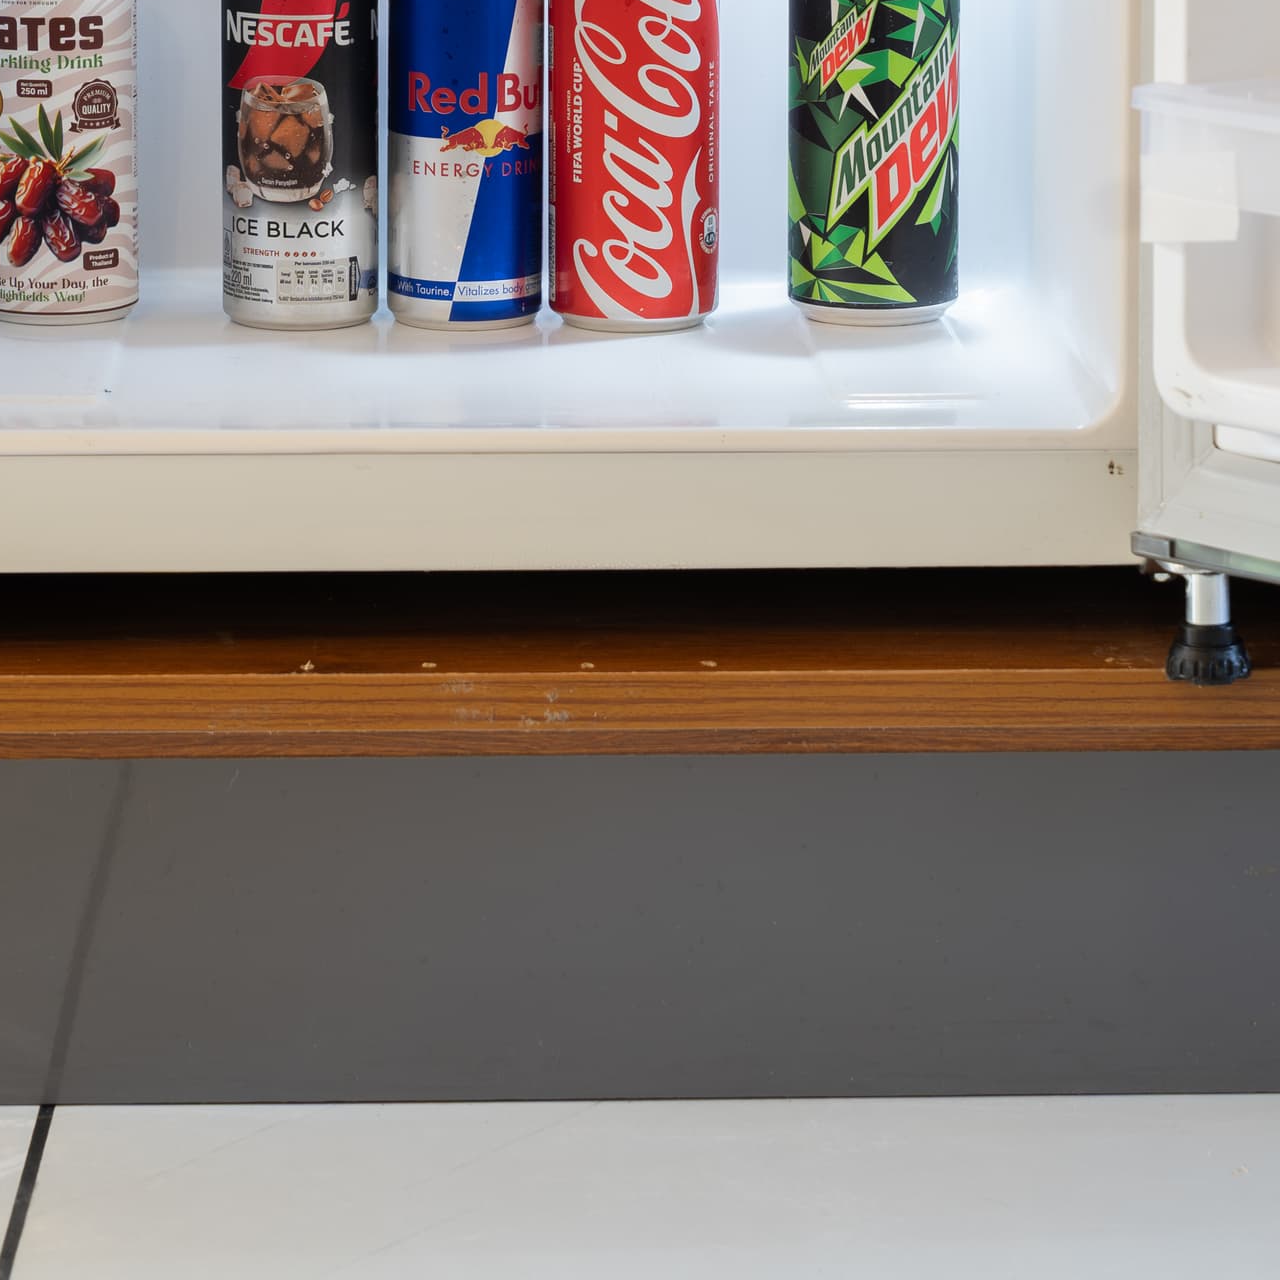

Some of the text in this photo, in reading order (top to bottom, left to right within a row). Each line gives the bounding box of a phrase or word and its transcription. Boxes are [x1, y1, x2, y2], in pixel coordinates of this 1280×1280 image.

[226, 2, 351, 48] NESCAFÉ
[808, 11, 856, 73] Mountain
[57, 53, 103, 70] Drink
[20, 87, 48, 95] 250 ml
[83, 89, 111, 102] PREMIUM
[408, 71, 489, 115] Red
[82, 103, 111, 115] QUALITY
[572, 92, 583, 152] WORLD
[833, 38, 952, 207] Mountain
[413, 160, 493, 177] ENERGY
[572, 153, 583, 184] FIFA
[232, 215, 345, 239] ICE BLACK
[243, 247, 280, 257] STRENGTH
[9, 277, 24, 291] Up
[28, 277, 58, 290] Your
[61, 278, 89, 290] Day,
[92, 275, 109, 287] the
[243, 272, 252, 286] ml
[397, 279, 452, 297] With Taurine.
[457, 284, 523, 297] Vitalizes body
[54, 290, 86, 304] Way!
